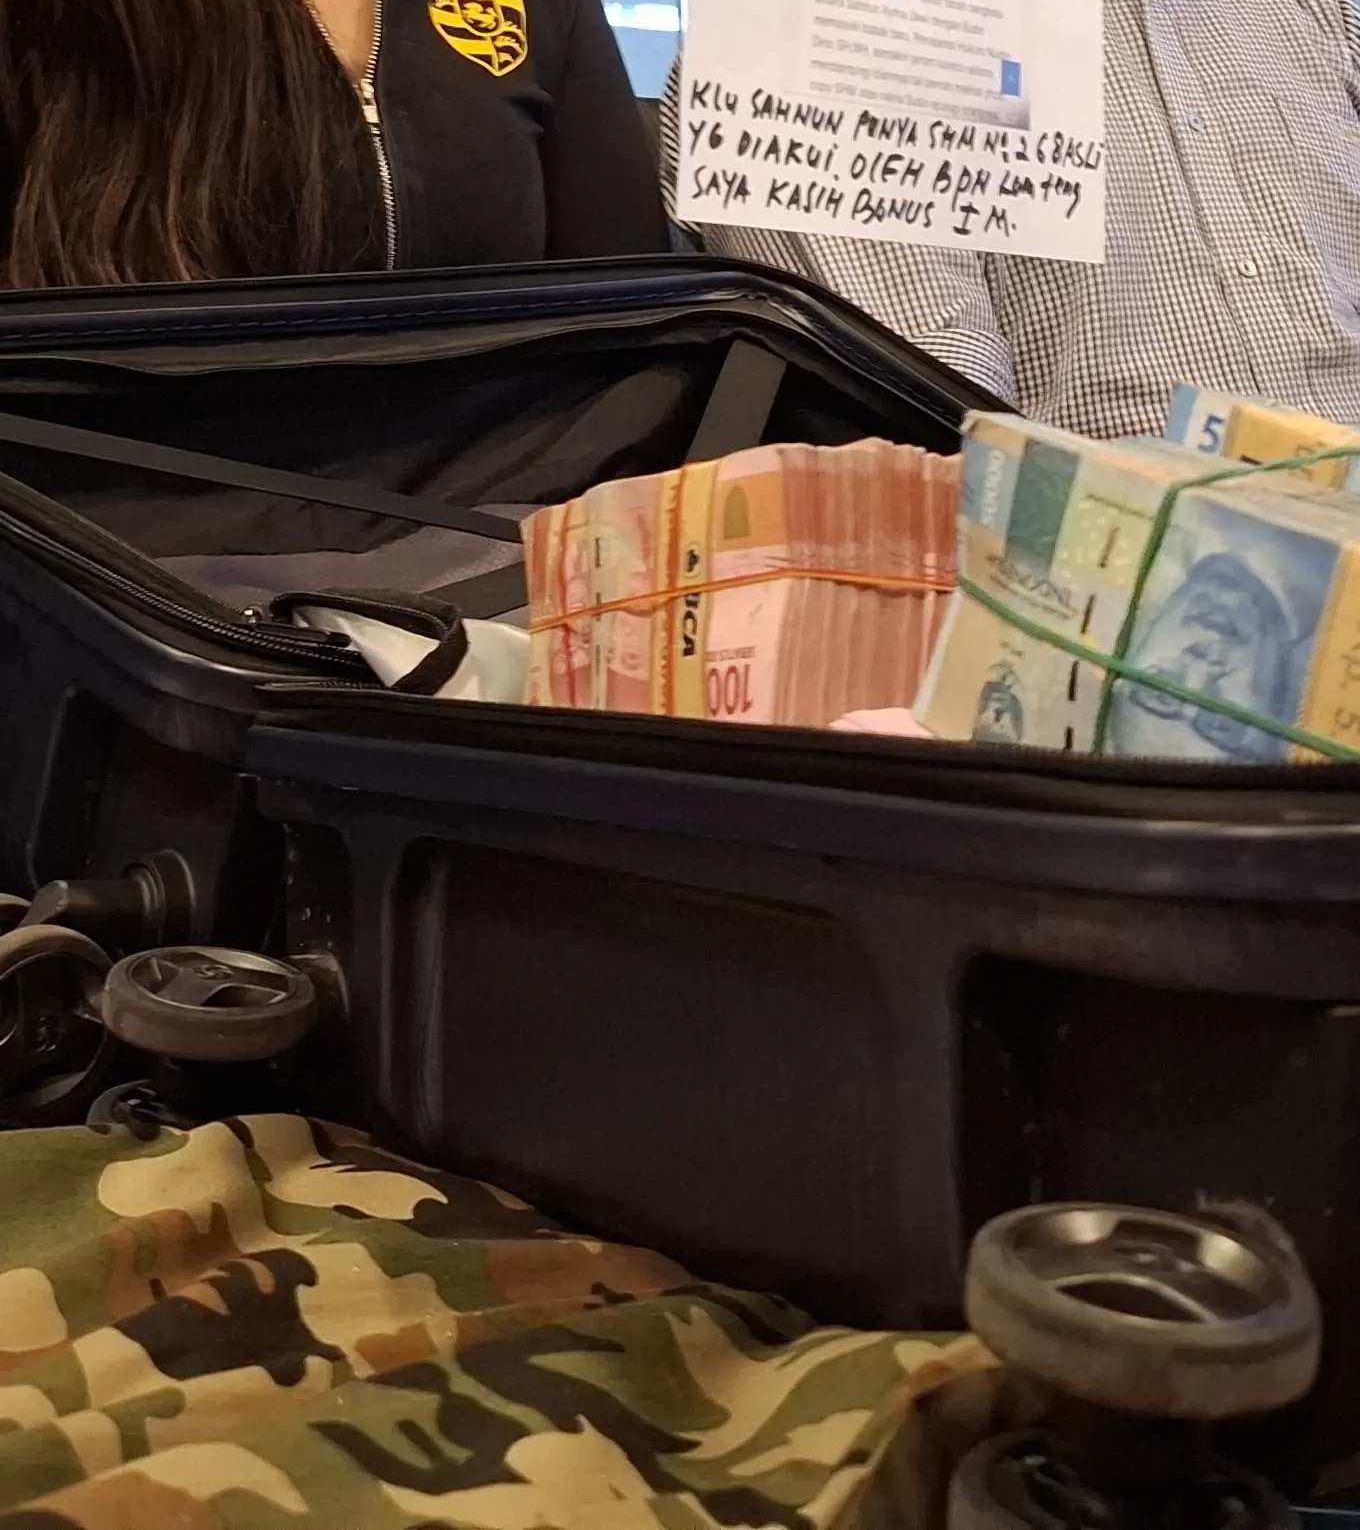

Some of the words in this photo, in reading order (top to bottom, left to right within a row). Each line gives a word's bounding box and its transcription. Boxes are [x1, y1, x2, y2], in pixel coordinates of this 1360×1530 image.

[692, 165, 751, 210] SAYA
[766, 178, 844, 219] KASIH
[851, 188, 936, 229] BONUS
